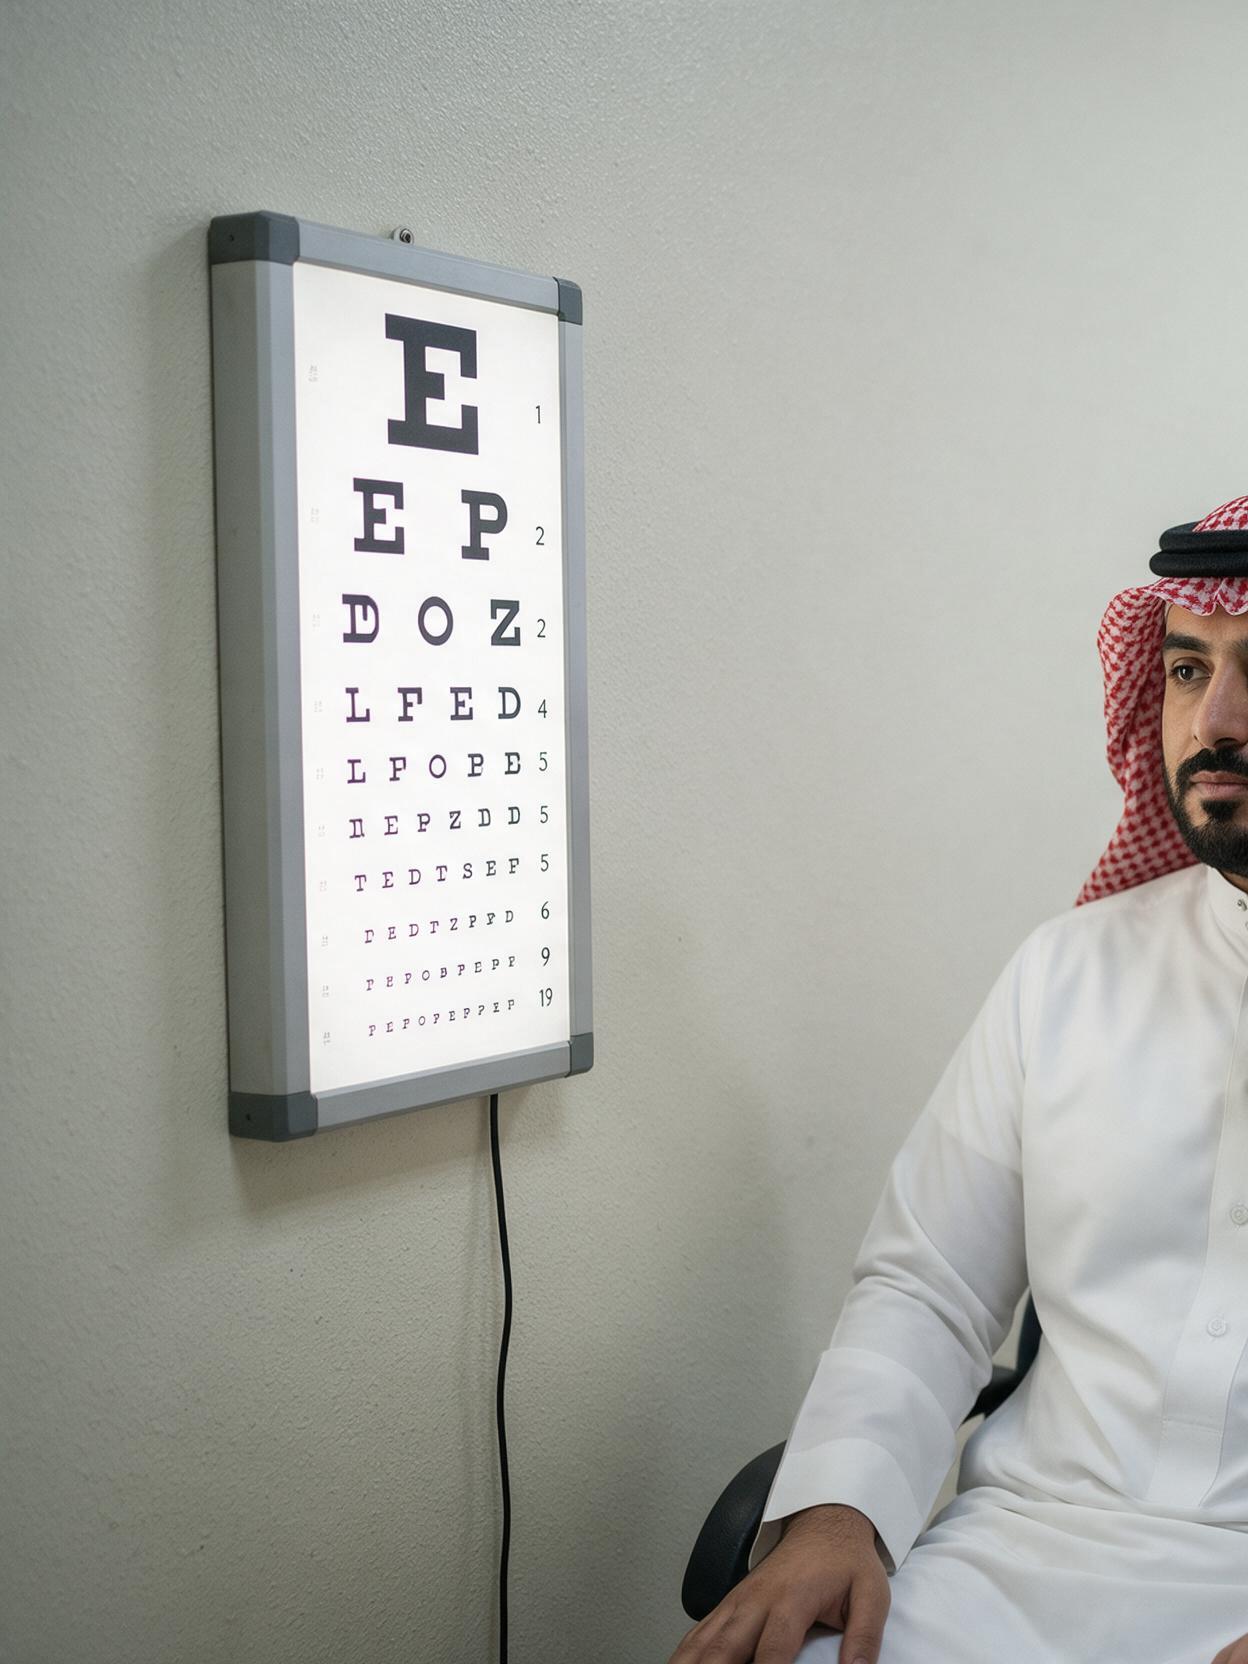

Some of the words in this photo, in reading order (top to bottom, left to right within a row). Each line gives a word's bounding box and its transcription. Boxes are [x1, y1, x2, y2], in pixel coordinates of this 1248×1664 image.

[385, 313, 479, 455] E
[535, 404, 541, 425] 1
[353, 477, 405, 555] E
[461, 489, 508, 561] P
[535, 525, 545, 546] 2
[418, 596, 453, 646] O
[490, 599, 521, 646] Z
[536, 618, 547, 639] 2
[345, 687, 370, 723] L
[398, 687, 422, 722] F
[450, 687, 473, 721] E
[498, 687, 521, 719] D
[537, 698, 548, 719] 4
[538, 751, 548, 772] 5
[539, 805, 549, 824] 5
[540, 853, 550, 873] 5
[540, 900, 550, 920] 6
[540, 946, 551, 967] 9
[538, 987, 553, 1008] 19
